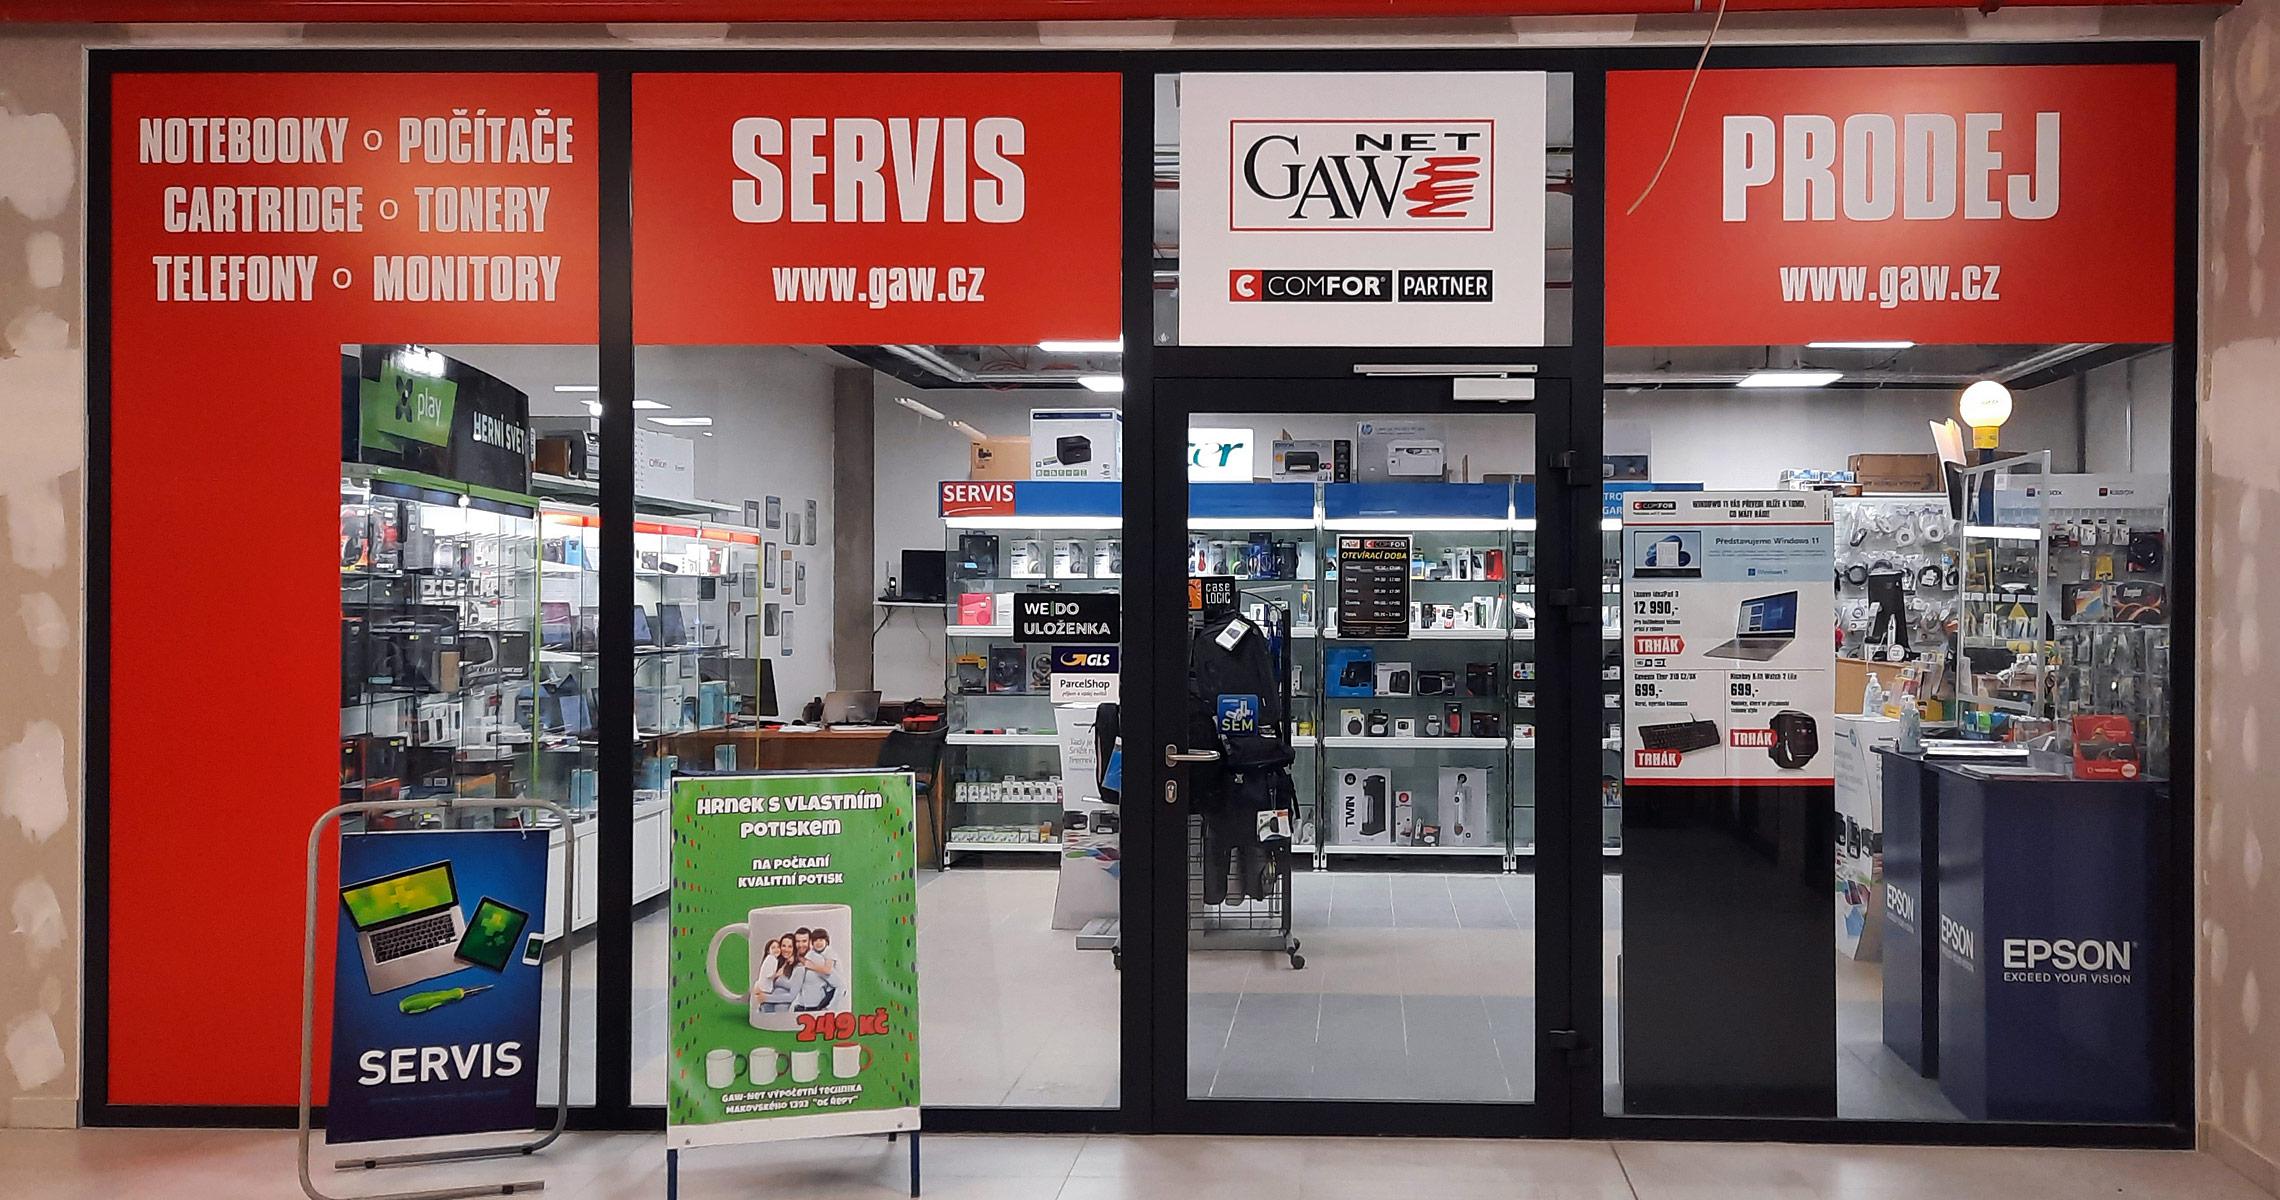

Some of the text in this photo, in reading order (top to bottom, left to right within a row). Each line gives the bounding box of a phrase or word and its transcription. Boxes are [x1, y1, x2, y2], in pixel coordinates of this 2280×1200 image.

[138, 109, 574, 164] NOTEBOOKY POČÍTAČE
[1355, 132, 1481, 151] NET
[731, 117, 1025, 222] SERVIS
[1722, 112, 2061, 222] PRODEJ
[1244, 135, 1413, 219] GAW
[163, 186, 550, 233] CARTRIDGE TONERY
[152, 256, 562, 302] TELEFONY MONITORY
[771, 266, 986, 309] www.gaw.cz
[1403, 276, 1488, 296] PARTNER
[1779, 264, 2001, 309] www.gaw.cz
[417, 387, 442, 427] play
[943, 484, 1014, 502] SERVIS
[1341, 550, 1384, 559] OTEVÍRACÍ
[1206, 583, 1230, 592] case
[1206, 592, 1231, 604] LOGIC
[1633, 601, 1679, 616] 12 990,-
[1023, 620, 1111, 635] ULOŽENKA
[1637, 637, 1680, 653] TRHÁK
[1087, 654, 1111, 666] GLS
[1060, 679, 1110, 690] ParcelShop
[1635, 684, 1663, 698] 699,-
[1730, 683, 1759, 697] 699,-
[1222, 718, 1254, 731] SEM
[1732, 729, 1773, 746] TRHÁK
[1638, 751, 1677, 766] TRHÁK
[767, 798, 779, 812] S
[1346, 796, 1355, 827] TWIN
[798, 872, 843, 885] POTISK
[1887, 883, 1914, 922] EPSON
[1941, 914, 1974, 960] EPSON
[2003, 938, 2131, 970] EPSON
[2003, 972, 2131, 984] EXCEED YOUR VISION
[796, 1011, 856, 1042] 249
[357, 1041, 522, 1086] SERVIS
